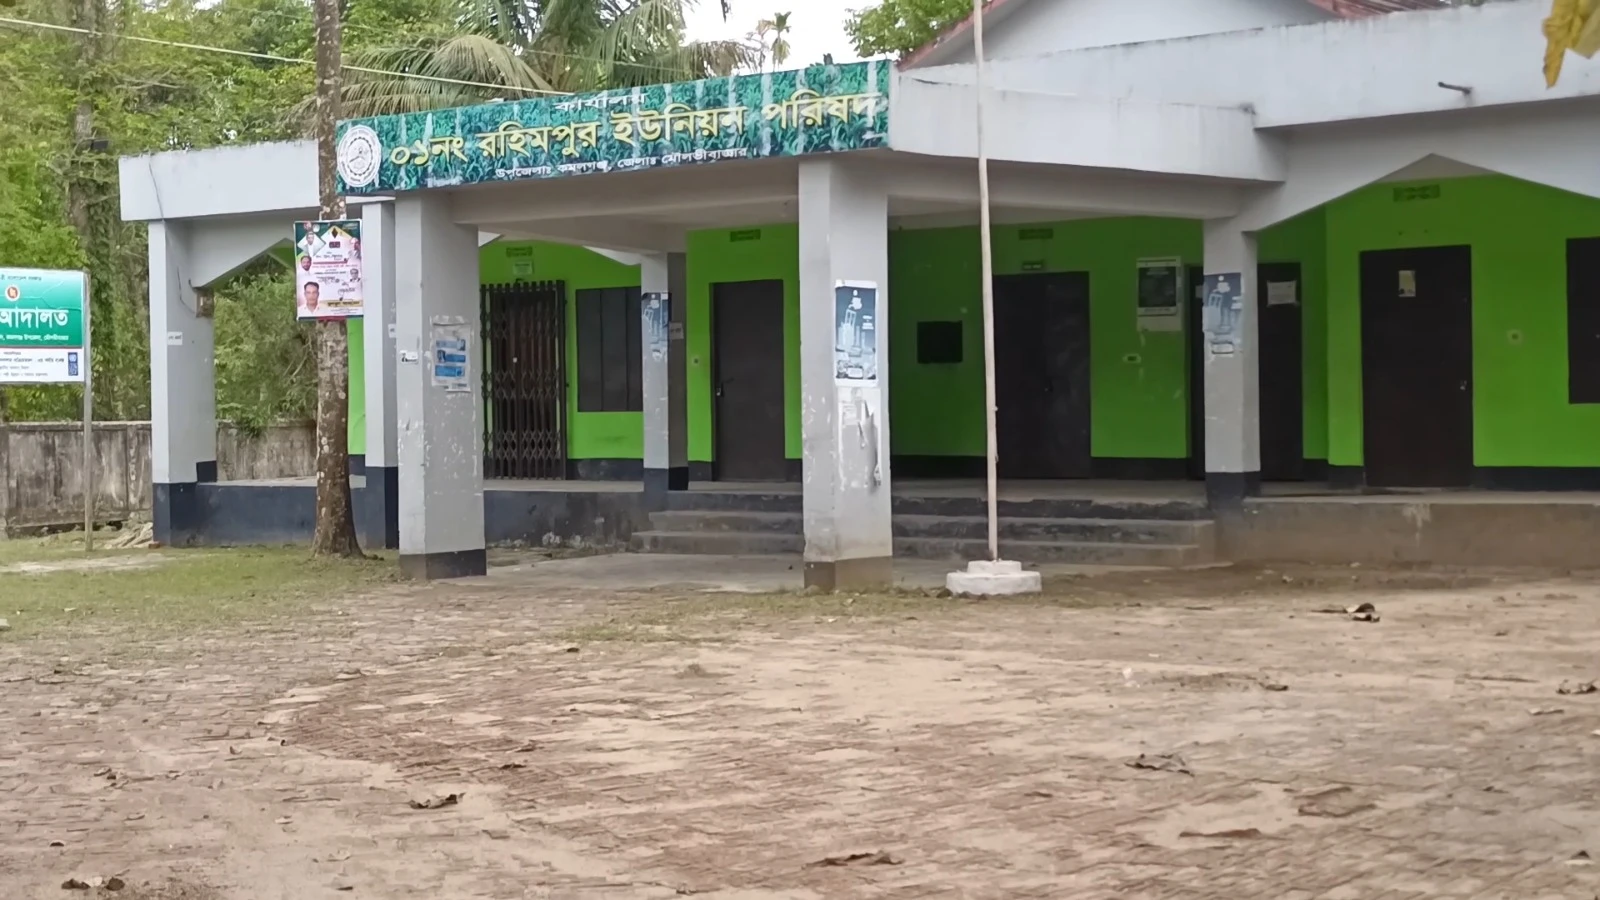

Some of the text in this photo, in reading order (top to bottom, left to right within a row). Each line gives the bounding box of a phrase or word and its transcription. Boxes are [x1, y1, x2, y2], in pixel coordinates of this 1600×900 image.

[391, 132, 469, 167] ০১নং
[476, 120, 602, 159] রহিমপুর
[610, 103, 748, 145] ইউনিয়ন
[761, 88, 882, 129] পরিষদ
